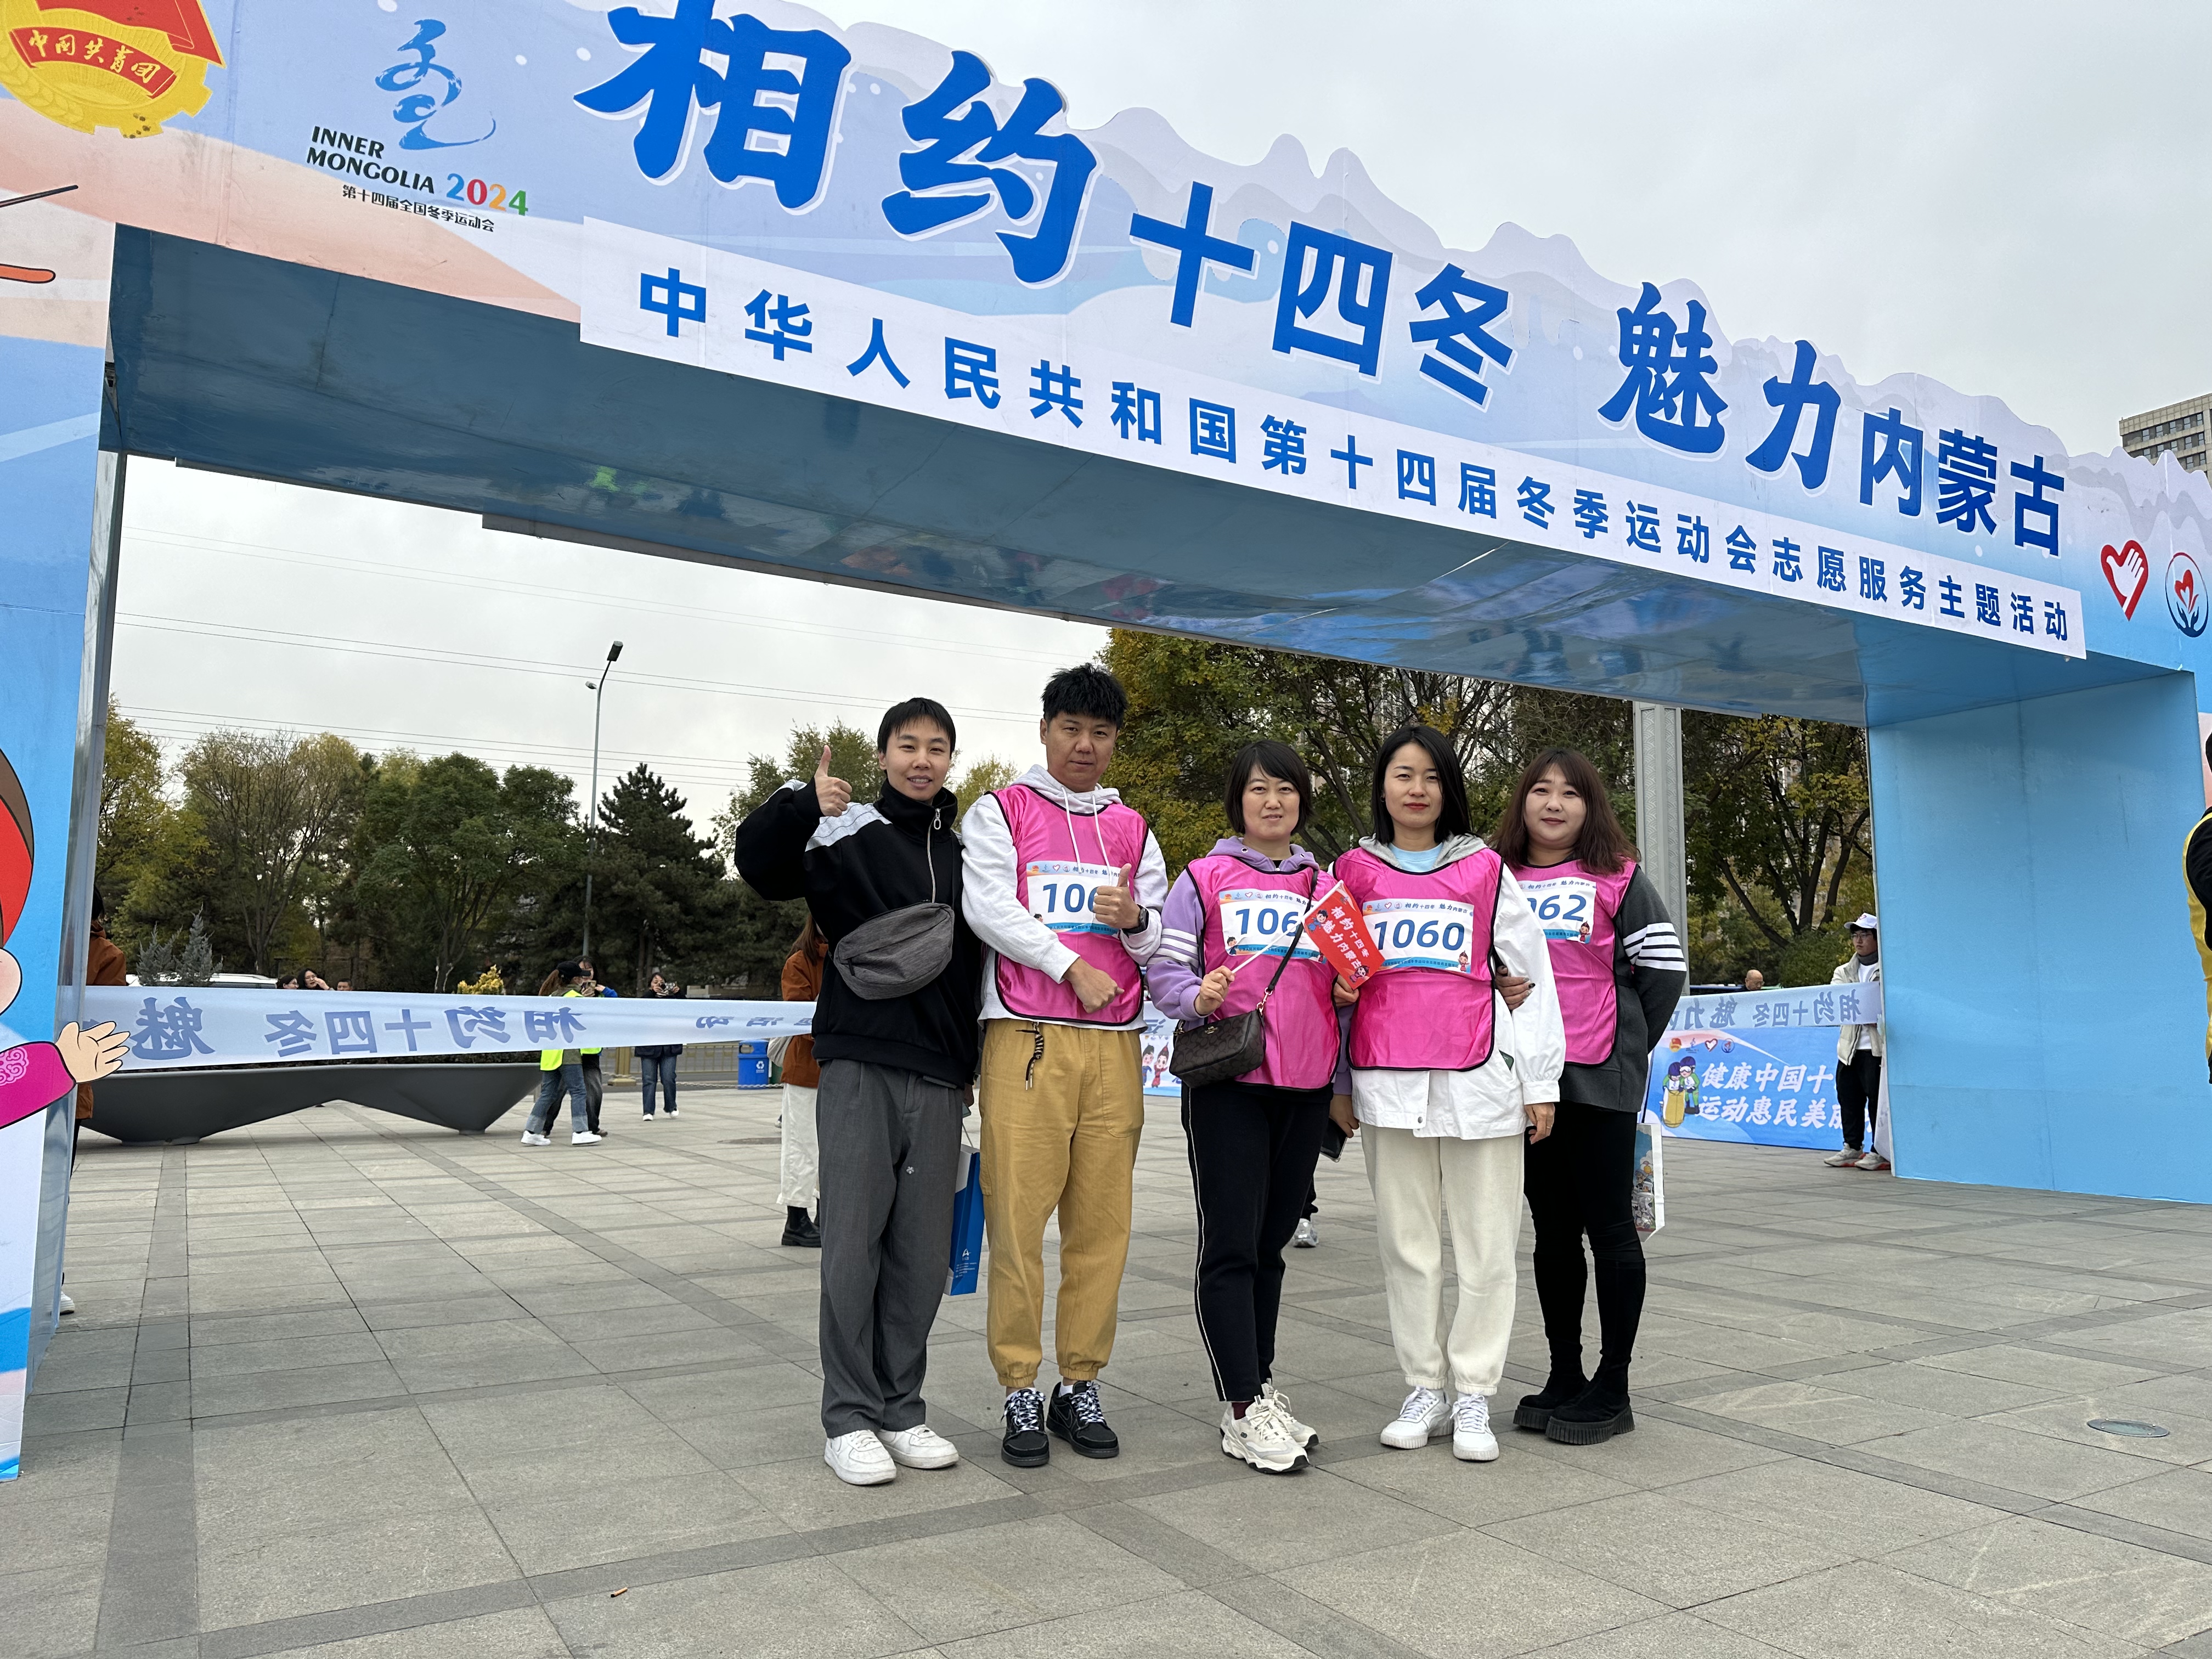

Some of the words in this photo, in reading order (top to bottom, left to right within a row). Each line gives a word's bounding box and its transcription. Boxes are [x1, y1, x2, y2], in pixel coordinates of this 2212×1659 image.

[29, 30, 161, 83] 中国共青团
[312, 126, 385, 159] INNER
[306, 147, 435, 194] MONGOLIA
[446, 173, 528, 216] 2024
[341, 184, 495, 233] 第十四届全国冬季运动会
[573, 0, 1515, 407] 相约十四冬
[1598, 281, 2066, 556] 魅力内蒙古
[640, 267, 2068, 641] 中华人民共和国第十四届冬季运动会志愿服务主题活动
[1235, 908, 1303, 936] 106
[1374, 919, 1465, 951] 1060
[1702, 1062, 1836, 1094] 健康中国十
